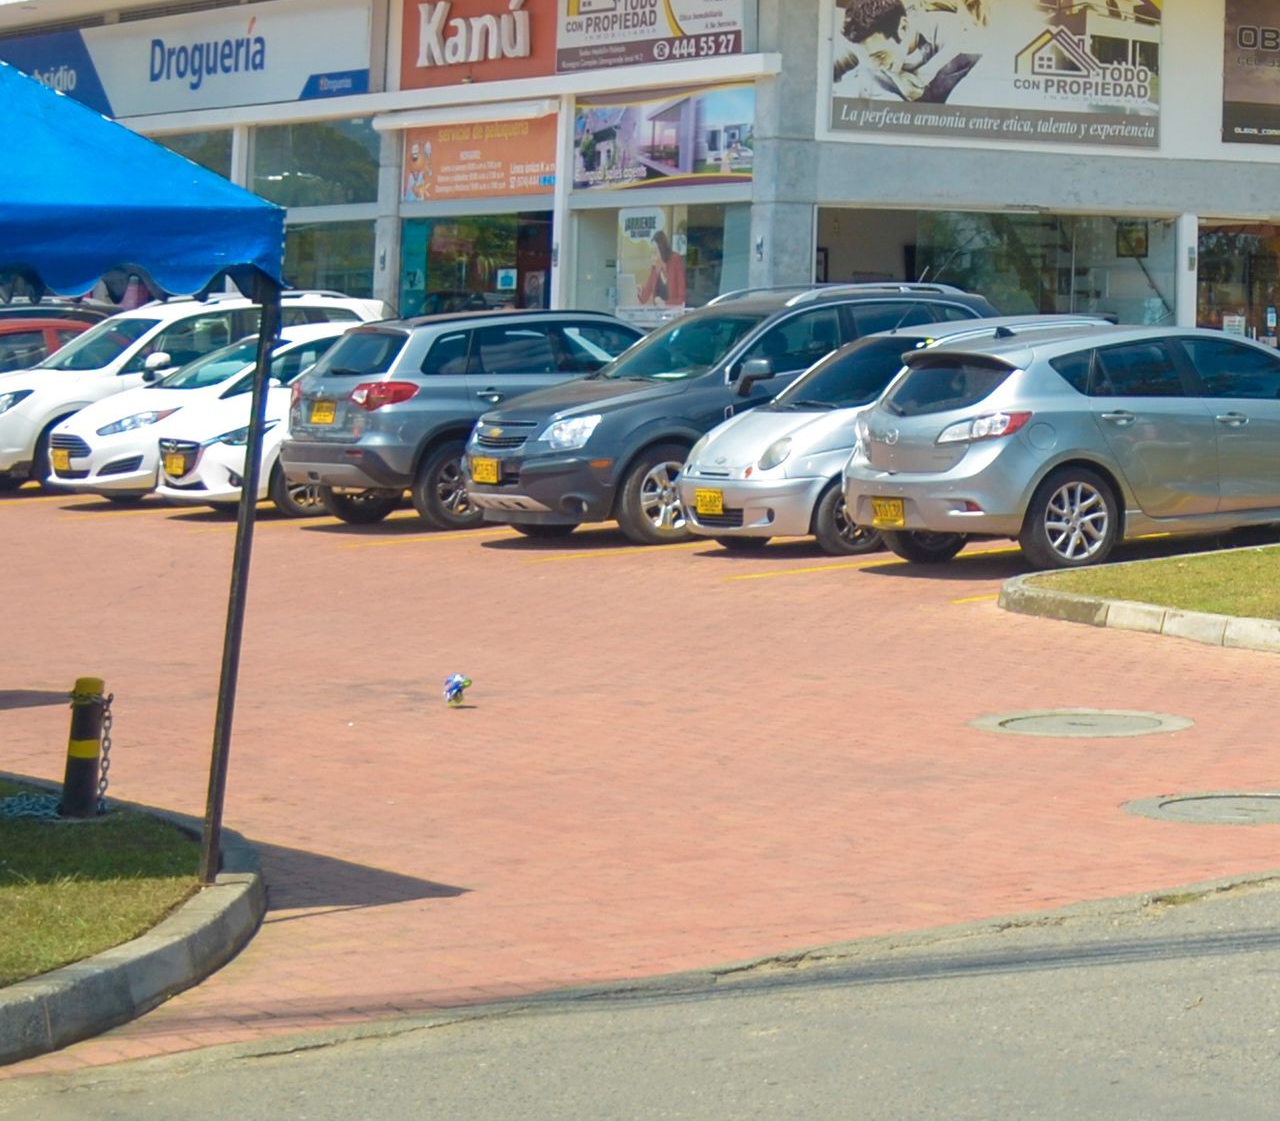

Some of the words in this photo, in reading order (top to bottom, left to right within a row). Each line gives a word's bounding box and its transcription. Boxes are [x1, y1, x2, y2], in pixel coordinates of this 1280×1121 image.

[566, 21, 584, 33] CON
[585, 10, 657, 34] PROPIEDAD
[150, 16, 265, 90] Droguería
[672, 38, 696, 58] 444
[700, 36, 716, 56] 55
[719, 34, 735, 54] 27
[1237, 56, 1260, 67] CEL
[1101, 65, 1149, 83] TODO
[1013, 78, 1040, 91] CON
[1044, 78, 1149, 99] PROPIEDAD
[840, 104, 858, 122] La
[860, 106, 912, 127] perfecta
[969, 116, 999, 131] entre
[1037, 117, 1077, 135] talento
[1078, 122, 1087, 138] y
[1089, 122, 1155, 139] experiencia
